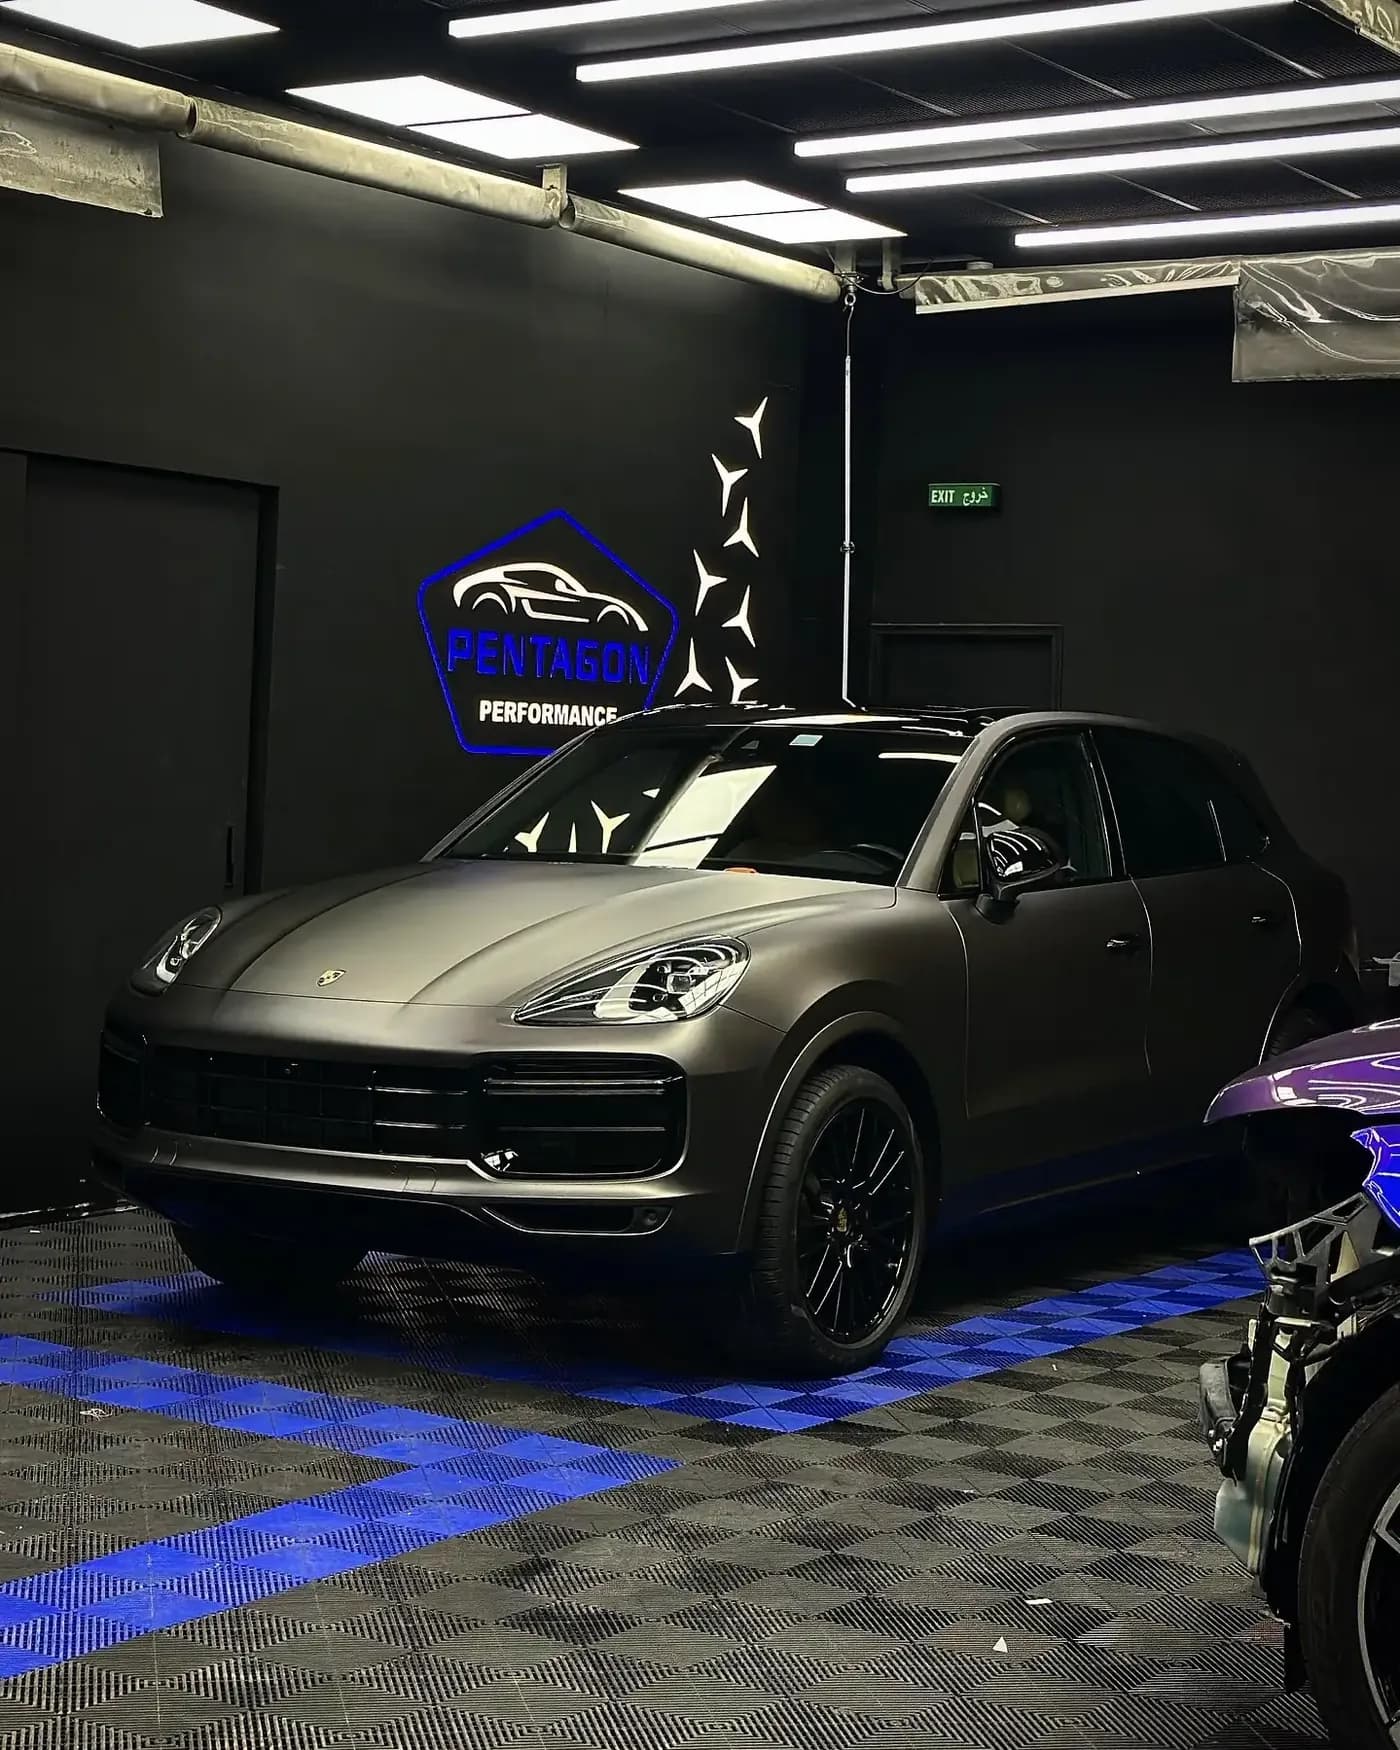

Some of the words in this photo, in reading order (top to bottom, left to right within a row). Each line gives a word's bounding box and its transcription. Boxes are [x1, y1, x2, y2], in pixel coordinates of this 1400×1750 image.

[931, 490, 955, 503] EXIT
[962, 487, 988, 506] خروج
[447, 629, 649, 685] PENTAGON
[479, 699, 618, 727] PERFORMANCE
